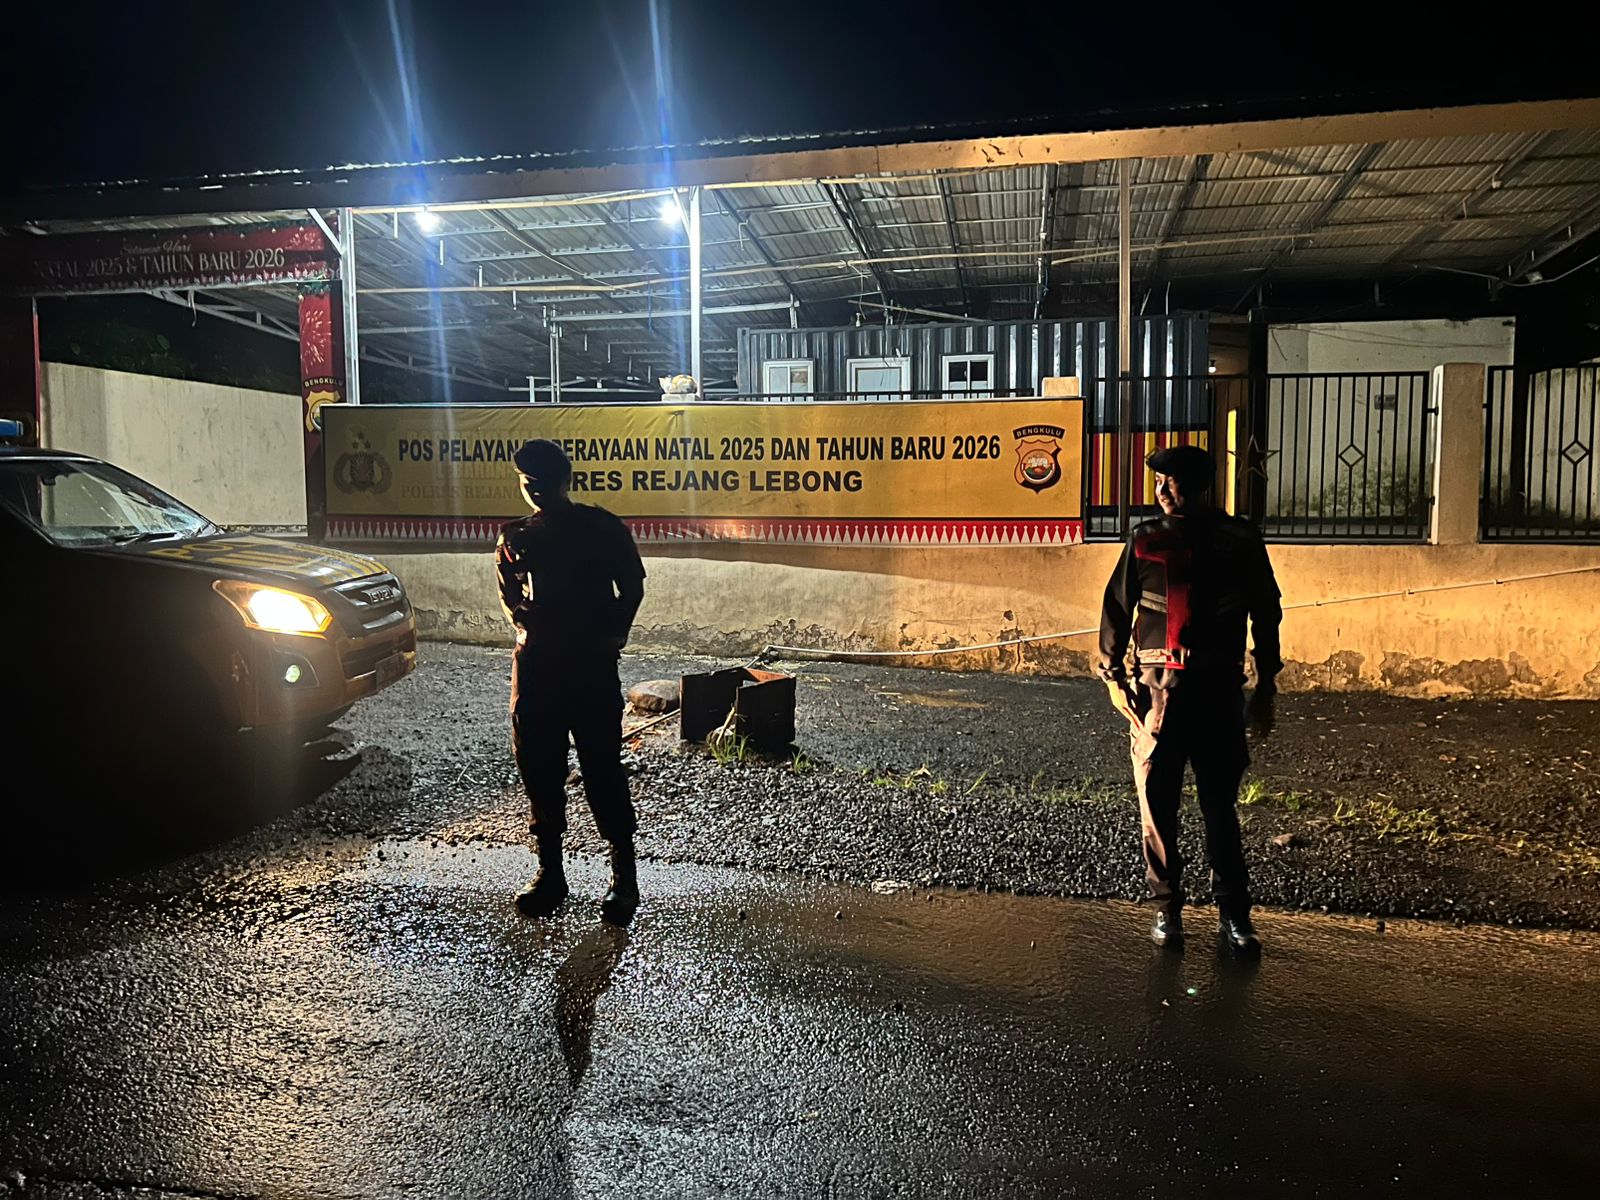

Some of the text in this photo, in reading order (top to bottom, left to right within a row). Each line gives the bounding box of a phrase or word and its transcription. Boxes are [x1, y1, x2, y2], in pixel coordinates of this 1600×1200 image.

[162, 239, 192, 254] Hari
[85, 256, 123, 277] 2025
[126, 255, 138, 275] &
[140, 252, 194, 275] TAHUN
[199, 250, 240, 272] BARU
[244, 247, 285, 270] 2026
[1015, 426, 1062, 438] BENGKULU
[397, 438, 434, 463] POS
[438, 438, 529, 463] PELAYAN
[654, 437, 714, 461] NATAL
[719, 436, 765, 461] 2025
[769, 436, 810, 461] DAN
[816, 436, 884, 461] TAHUN
[890, 435, 945, 460] BARU
[951, 435, 1001, 460] 2026
[567, 469, 864, 493] RES REJANG LEBONG
